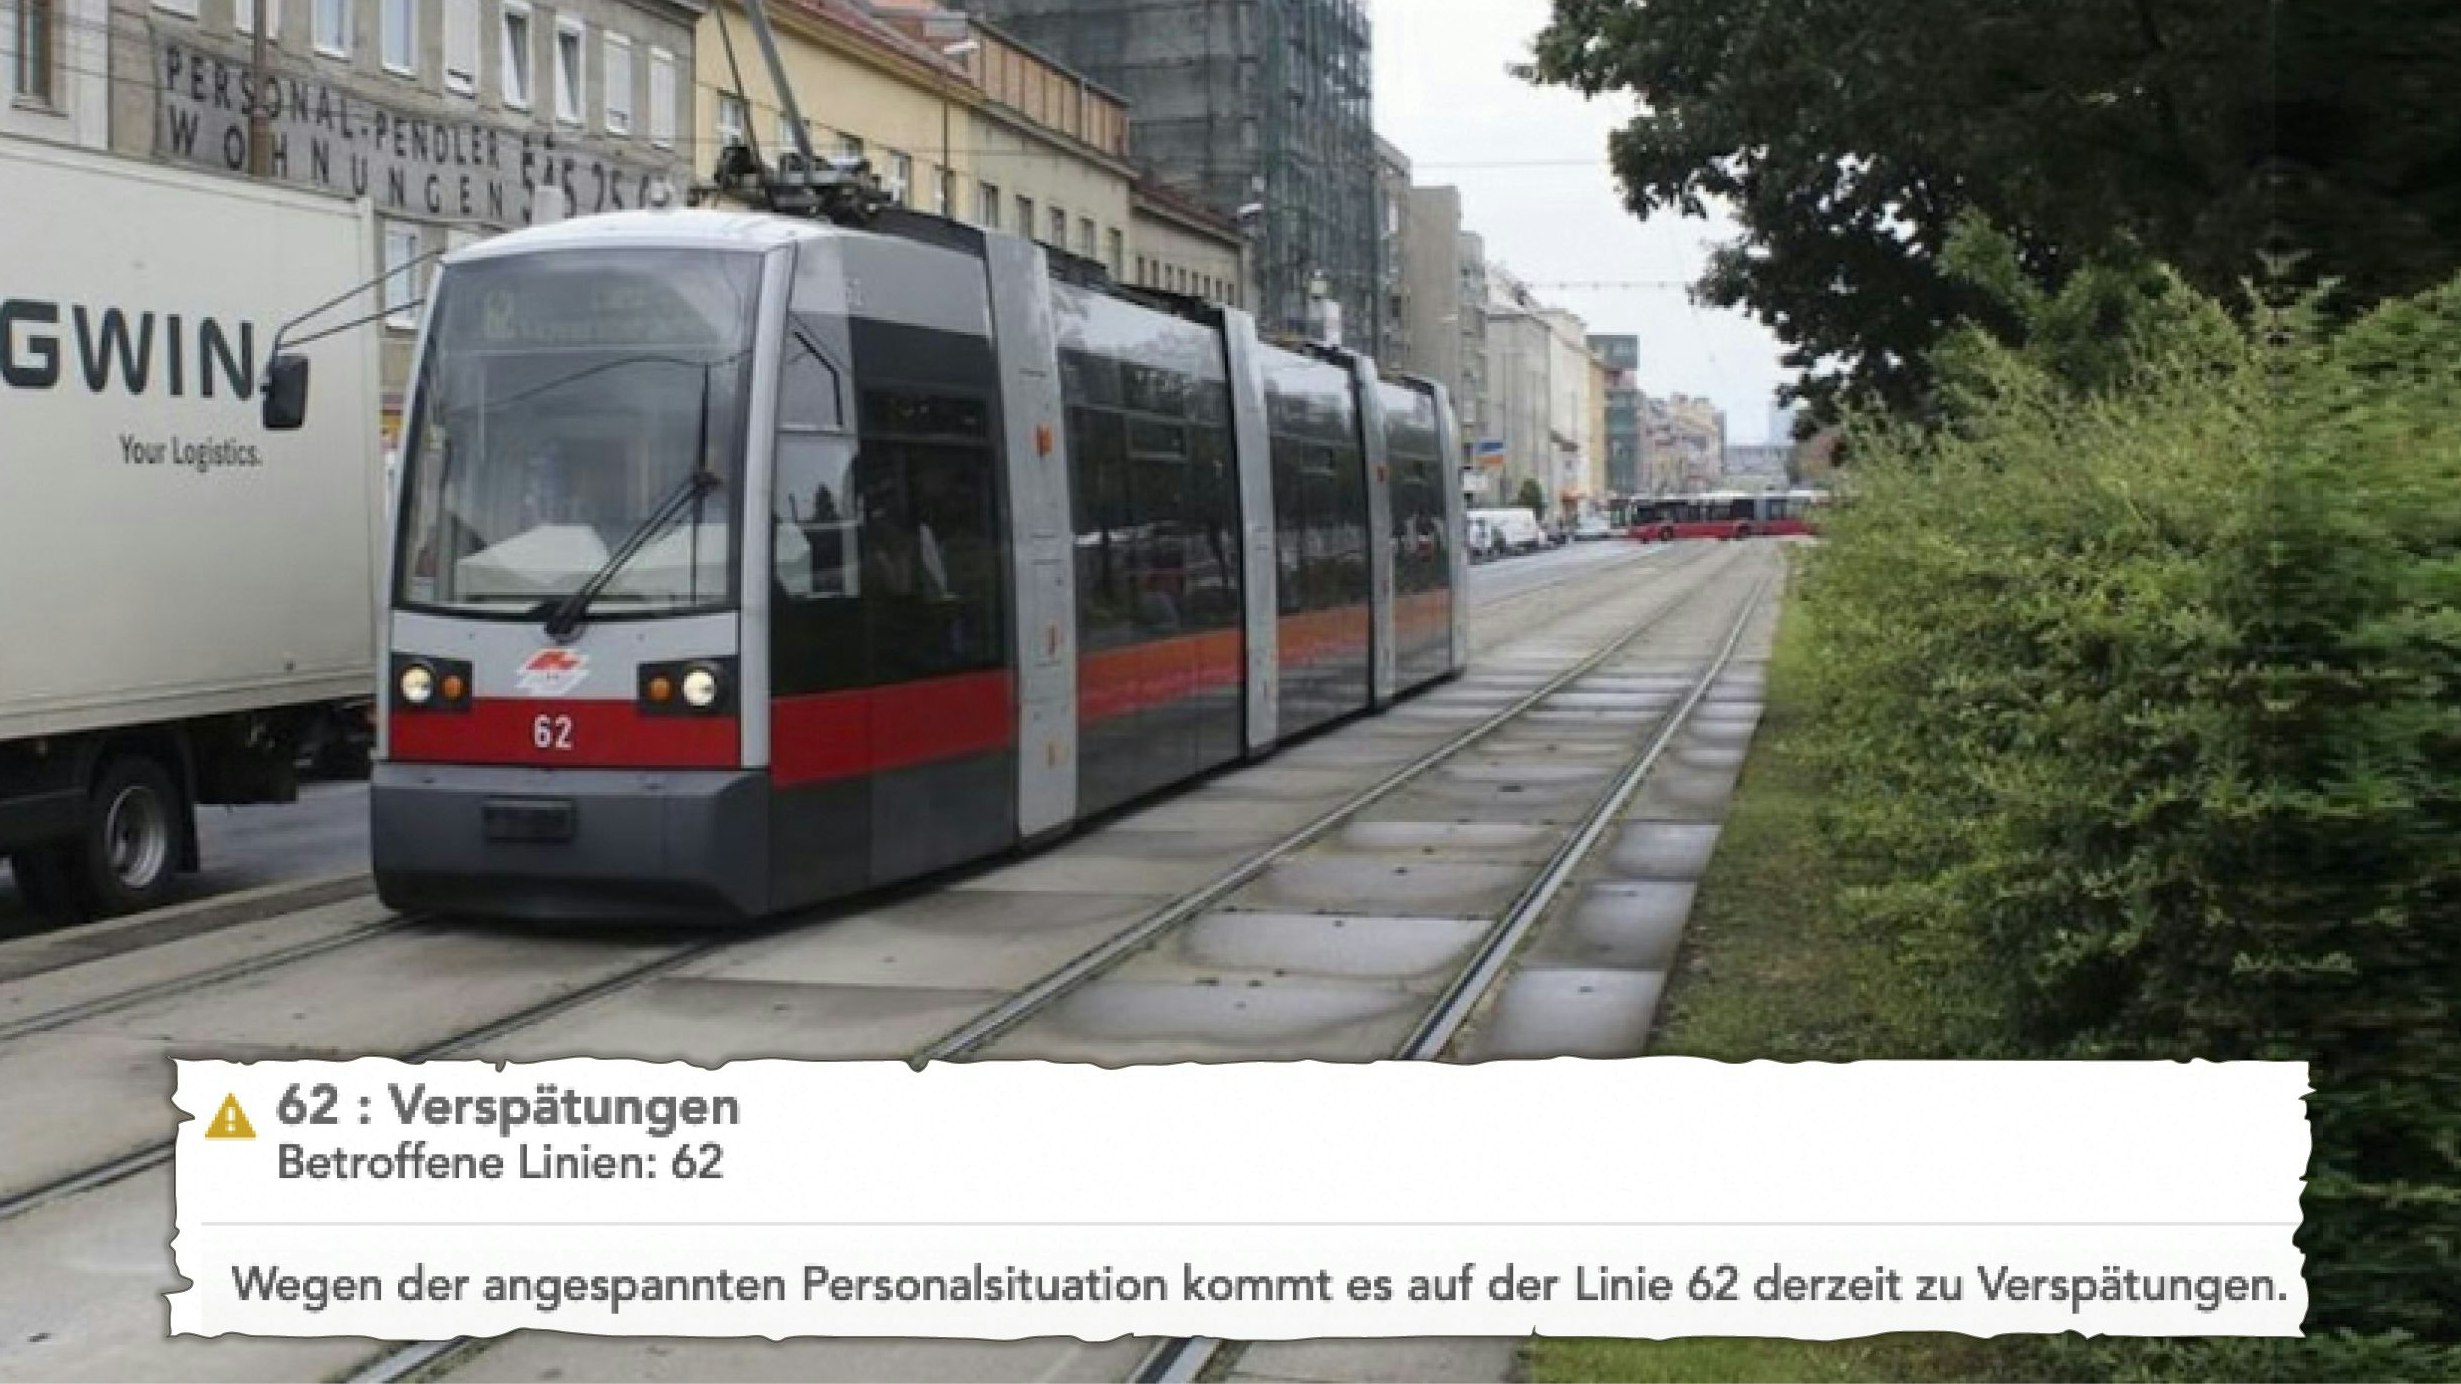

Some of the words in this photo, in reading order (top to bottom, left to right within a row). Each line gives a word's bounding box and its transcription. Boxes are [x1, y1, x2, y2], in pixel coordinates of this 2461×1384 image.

[169, 104, 502, 218] WOHNUNGEN
[0, 298, 255, 401] GWIN
[120, 434, 166, 464] Your
[171, 435, 263, 472] Logistics.
[534, 714, 572, 750] 62
